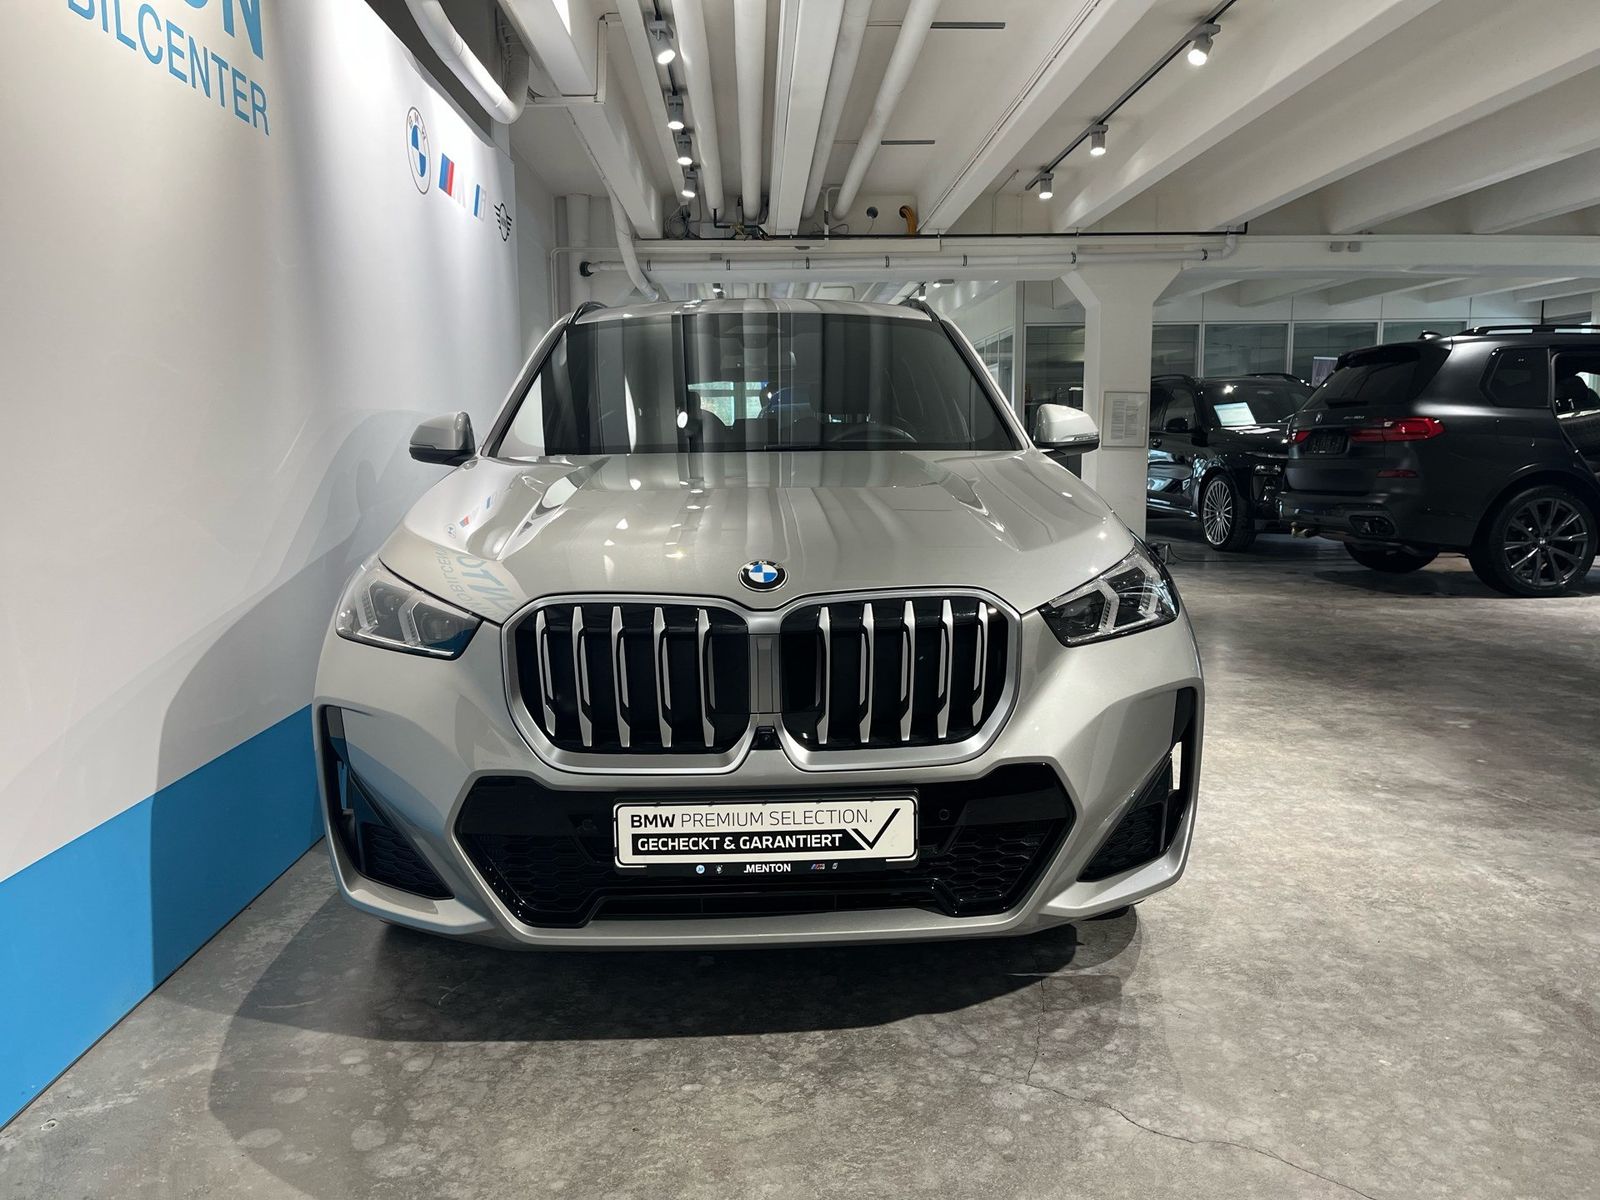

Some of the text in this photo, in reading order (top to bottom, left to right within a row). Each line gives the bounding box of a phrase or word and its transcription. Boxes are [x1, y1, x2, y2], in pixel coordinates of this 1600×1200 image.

[68, 0, 269, 136] ILCENTER
[630, 808, 873, 829] BMW PREMIUM SELECTION.
[637, 833, 843, 851] GECHECKT & GARANTIERT
[743, 863, 792, 874] MENTON
